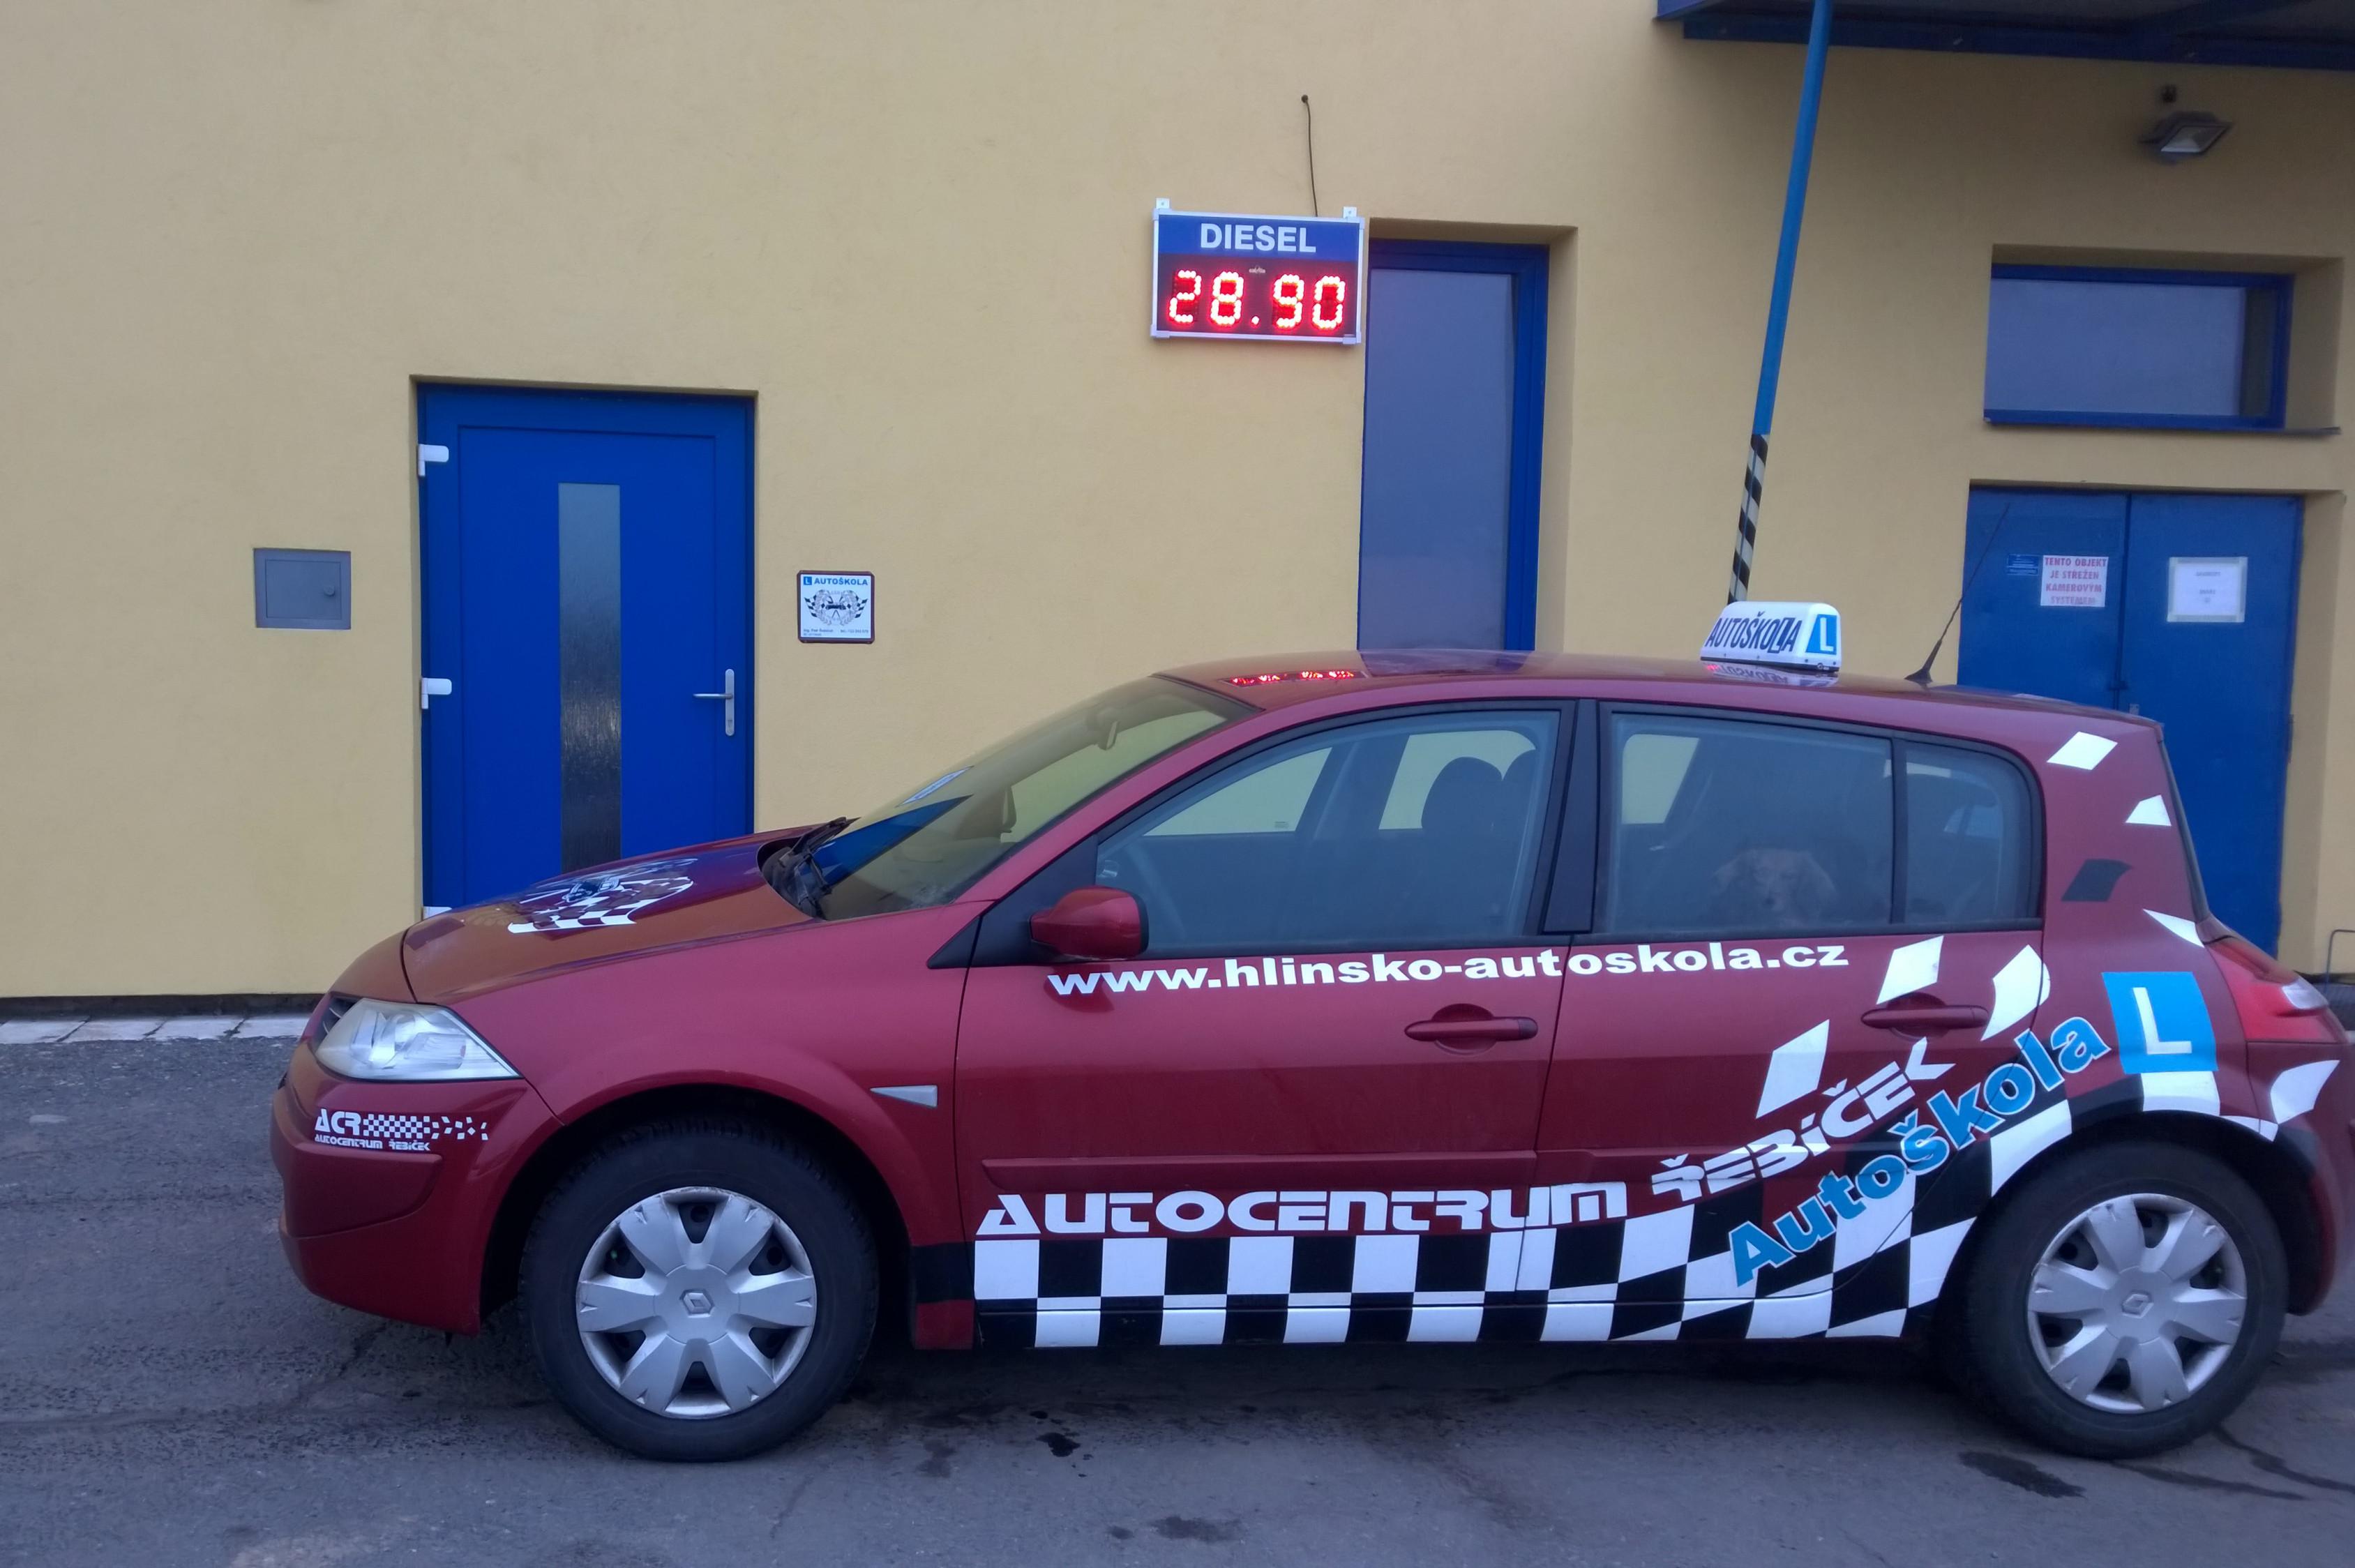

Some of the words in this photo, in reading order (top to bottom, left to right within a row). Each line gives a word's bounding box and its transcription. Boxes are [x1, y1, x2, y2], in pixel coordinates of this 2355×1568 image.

[1200, 222, 1317, 253] DIESEL
[1168, 269, 1346, 329] 28.90
[2045, 557, 2072, 566] TENTO
[2075, 559, 2107, 567] OBJEKT
[2049, 571, 2059, 579] JE
[1705, 611, 1803, 654] AUTOŠKOLA
[1819, 617, 1834, 652] L
[1048, 942, 1849, 995] www.hlinsko-autoskola.cz
[2132, 987, 2192, 1055] L
[315, 1108, 361, 1136] ACR
[1727, 1016, 2112, 1288] Autoškola
